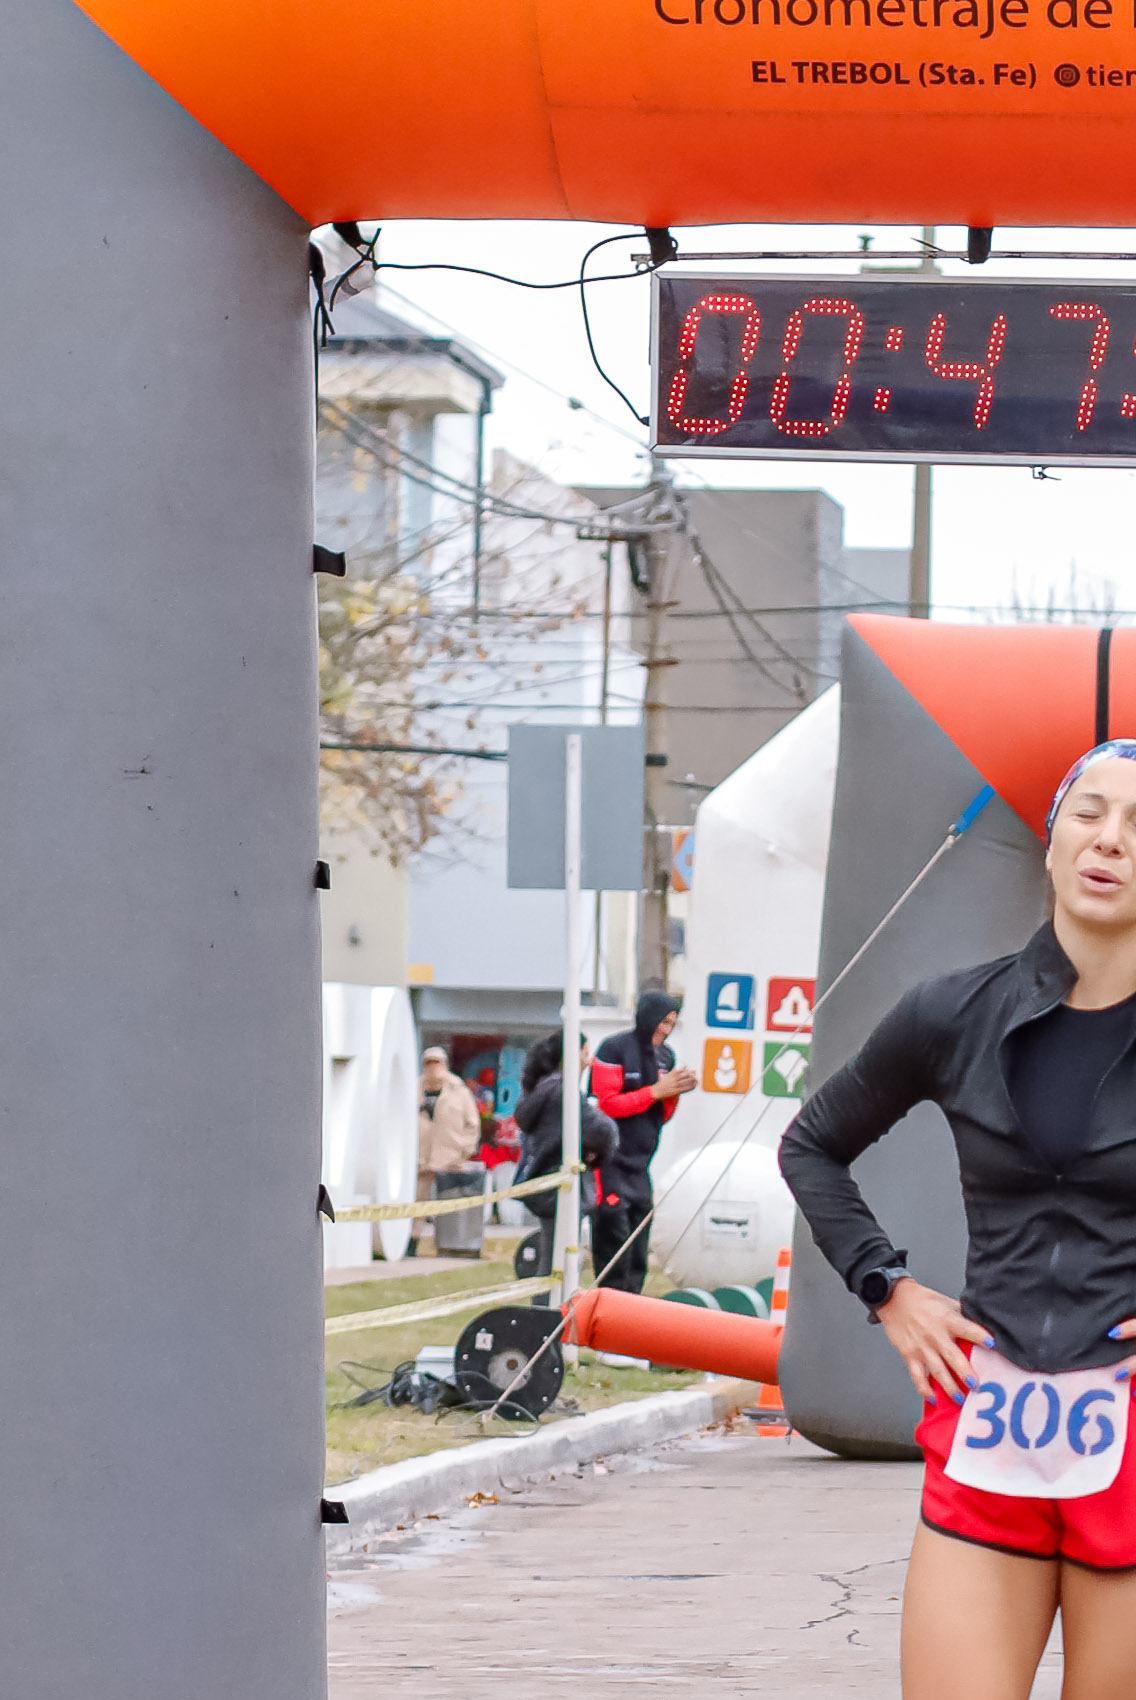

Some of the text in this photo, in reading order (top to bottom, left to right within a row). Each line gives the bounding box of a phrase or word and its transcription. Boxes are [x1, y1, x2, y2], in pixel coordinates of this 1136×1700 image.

[654, 0, 1029, 39] Cronometraje
[1047, 0, 1113, 28] de
[751, 61, 786, 84] EL
[792, 62, 910, 86] TREBOL
[918, 62, 986, 88] (Sta.
[994, 63, 1037, 88] Fe)
[965, 1381, 1116, 1456] 306
